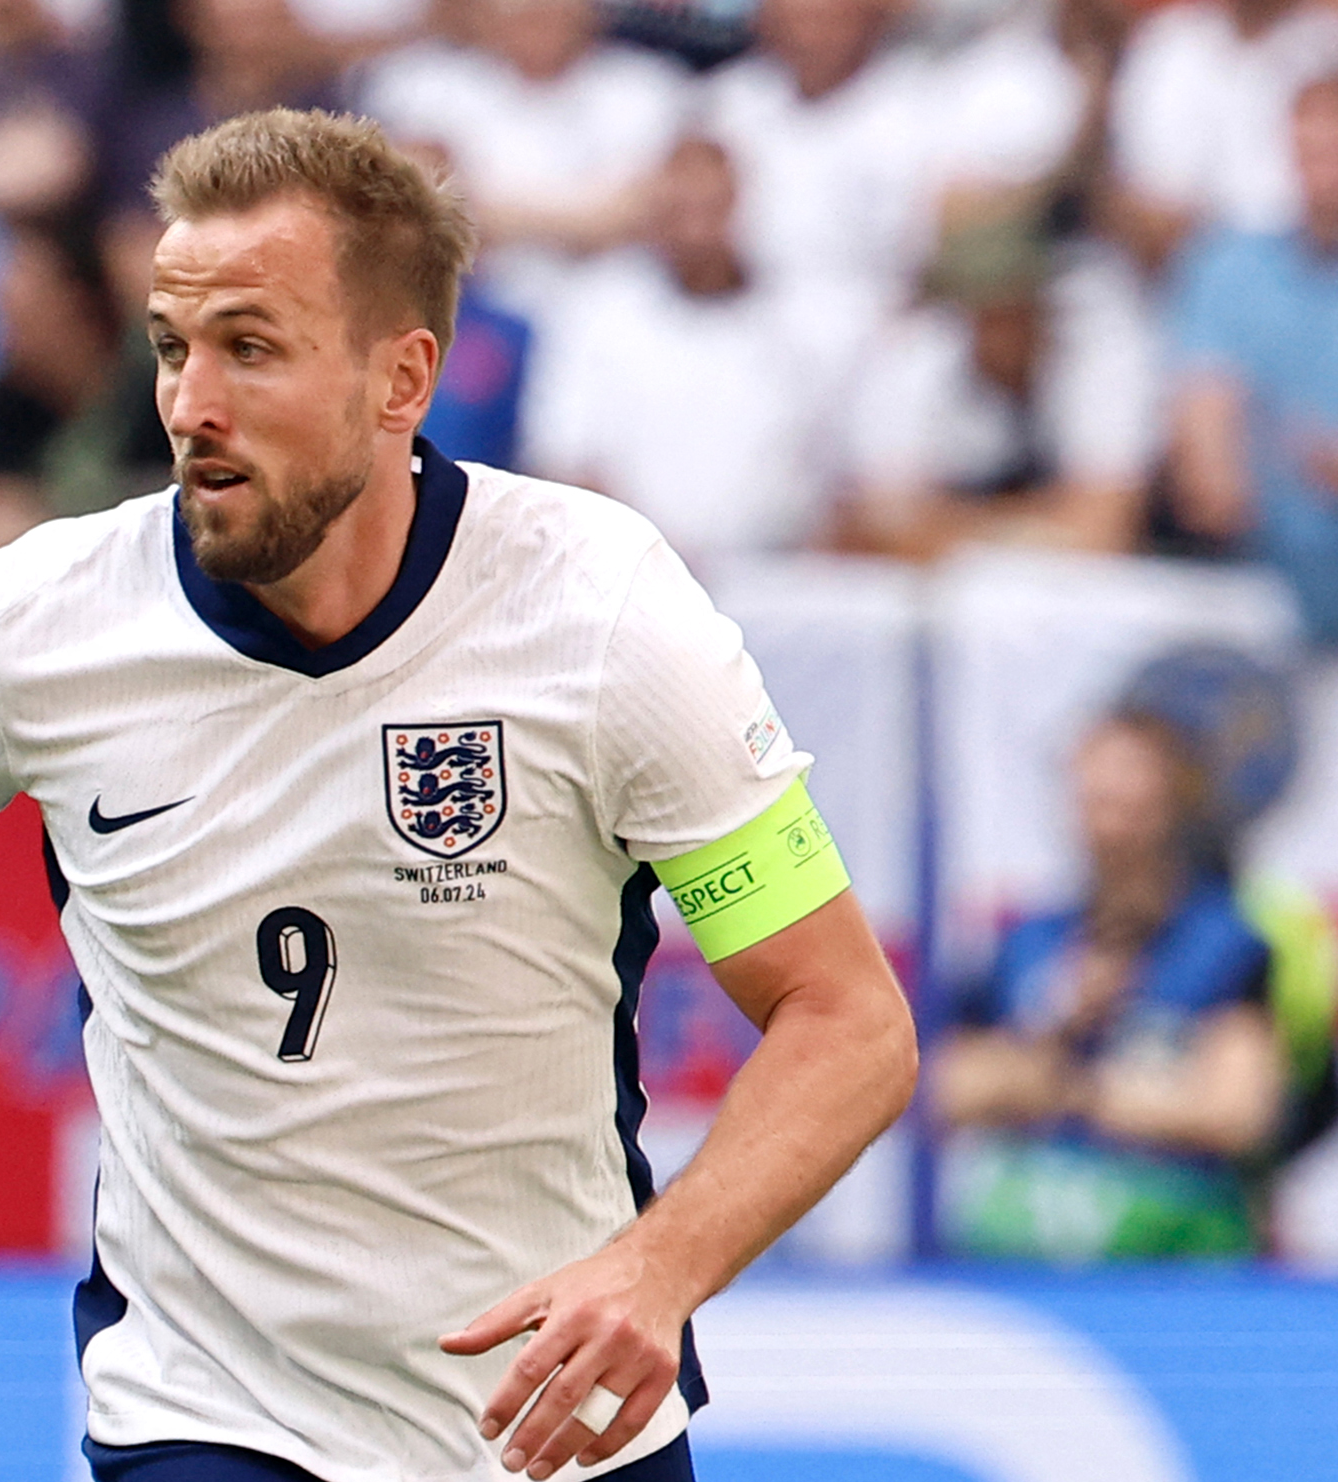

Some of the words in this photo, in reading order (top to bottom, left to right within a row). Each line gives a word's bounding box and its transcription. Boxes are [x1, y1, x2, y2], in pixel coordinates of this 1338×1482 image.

[393, 859, 508, 884] SWITZERLAND
[420, 881, 487, 904] 06.07.24
[256, 906, 338, 1063] 9
